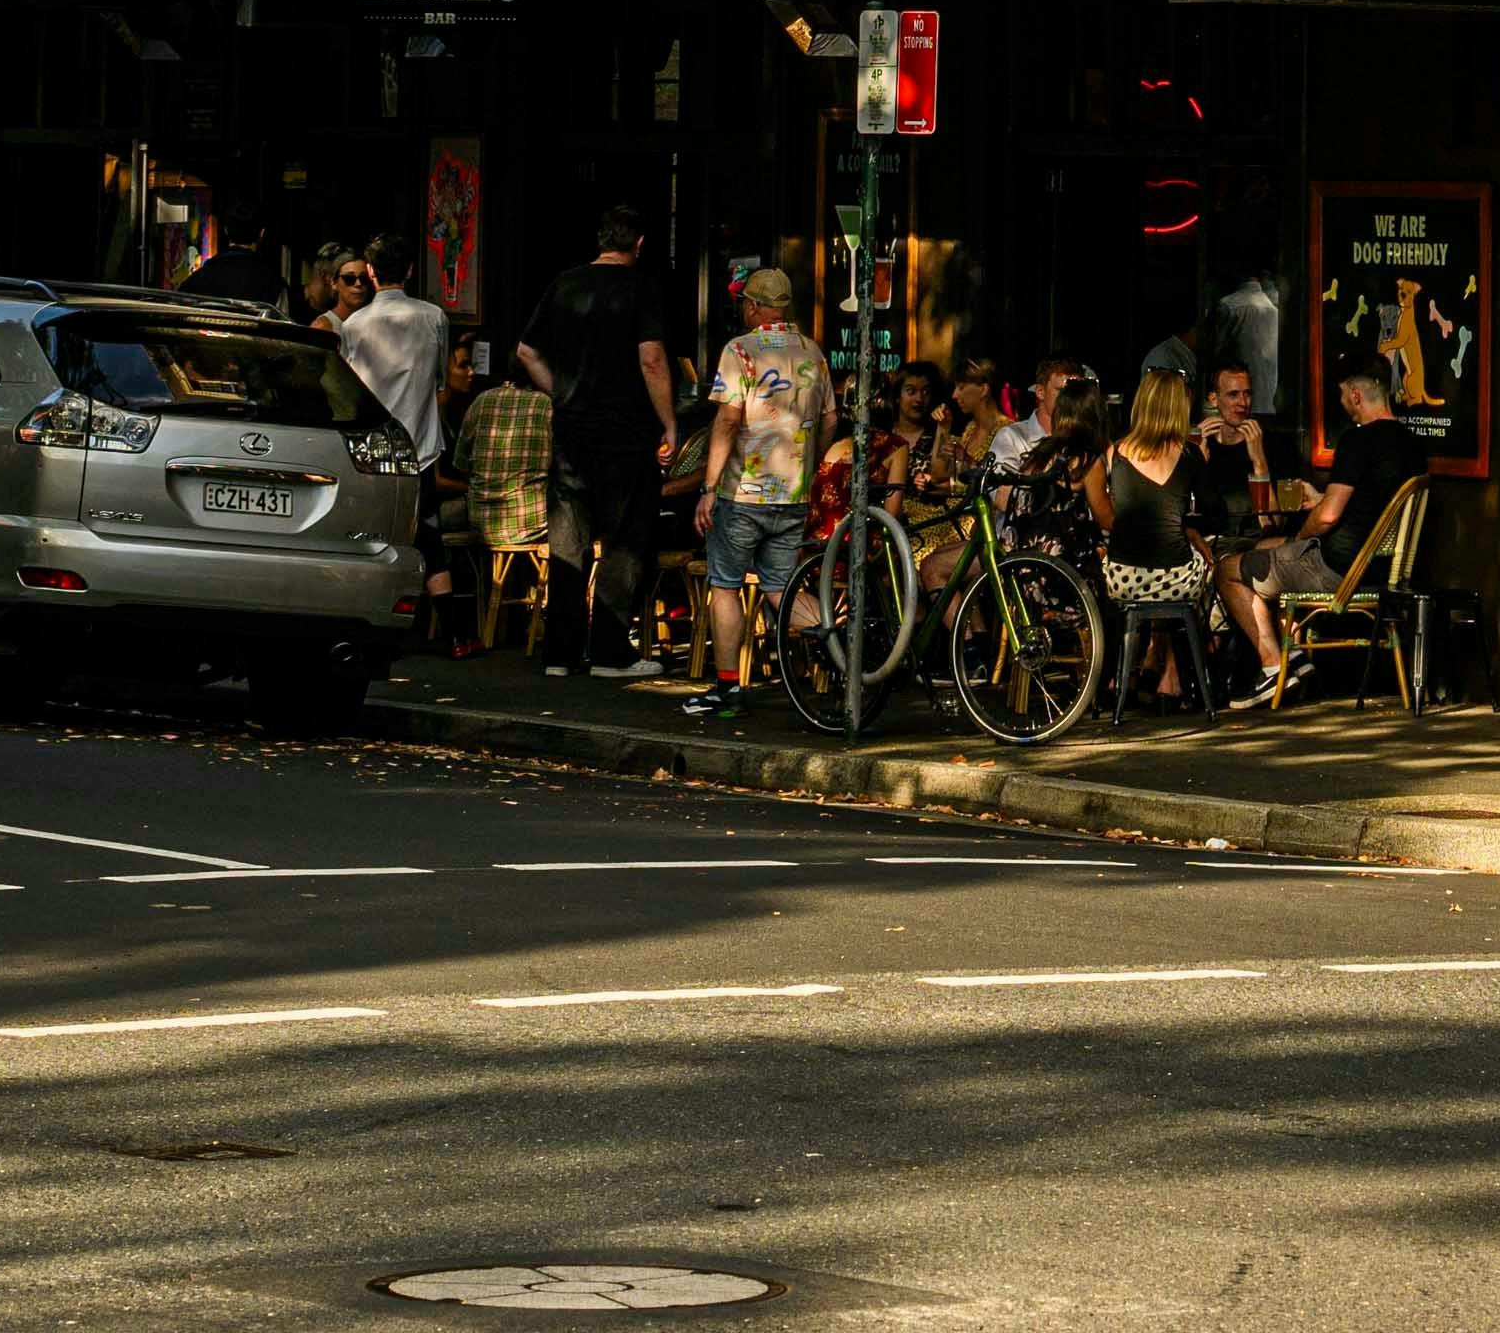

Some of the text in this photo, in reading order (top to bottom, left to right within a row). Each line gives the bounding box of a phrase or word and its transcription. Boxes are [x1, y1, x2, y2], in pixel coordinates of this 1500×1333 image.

[423, 13, 456, 25] BAR
[913, 19, 924, 32] NO
[903, 36, 933, 49] STOPPING
[1375, 215, 1426, 238] WE ARE
[1353, 241, 1449, 267] DOG FRIENDLY
[1408, 416, 1452, 426] ACCOMPANIED
[1415, 427, 1428, 436] ALL
[1428, 428, 1446, 437] TIMES
